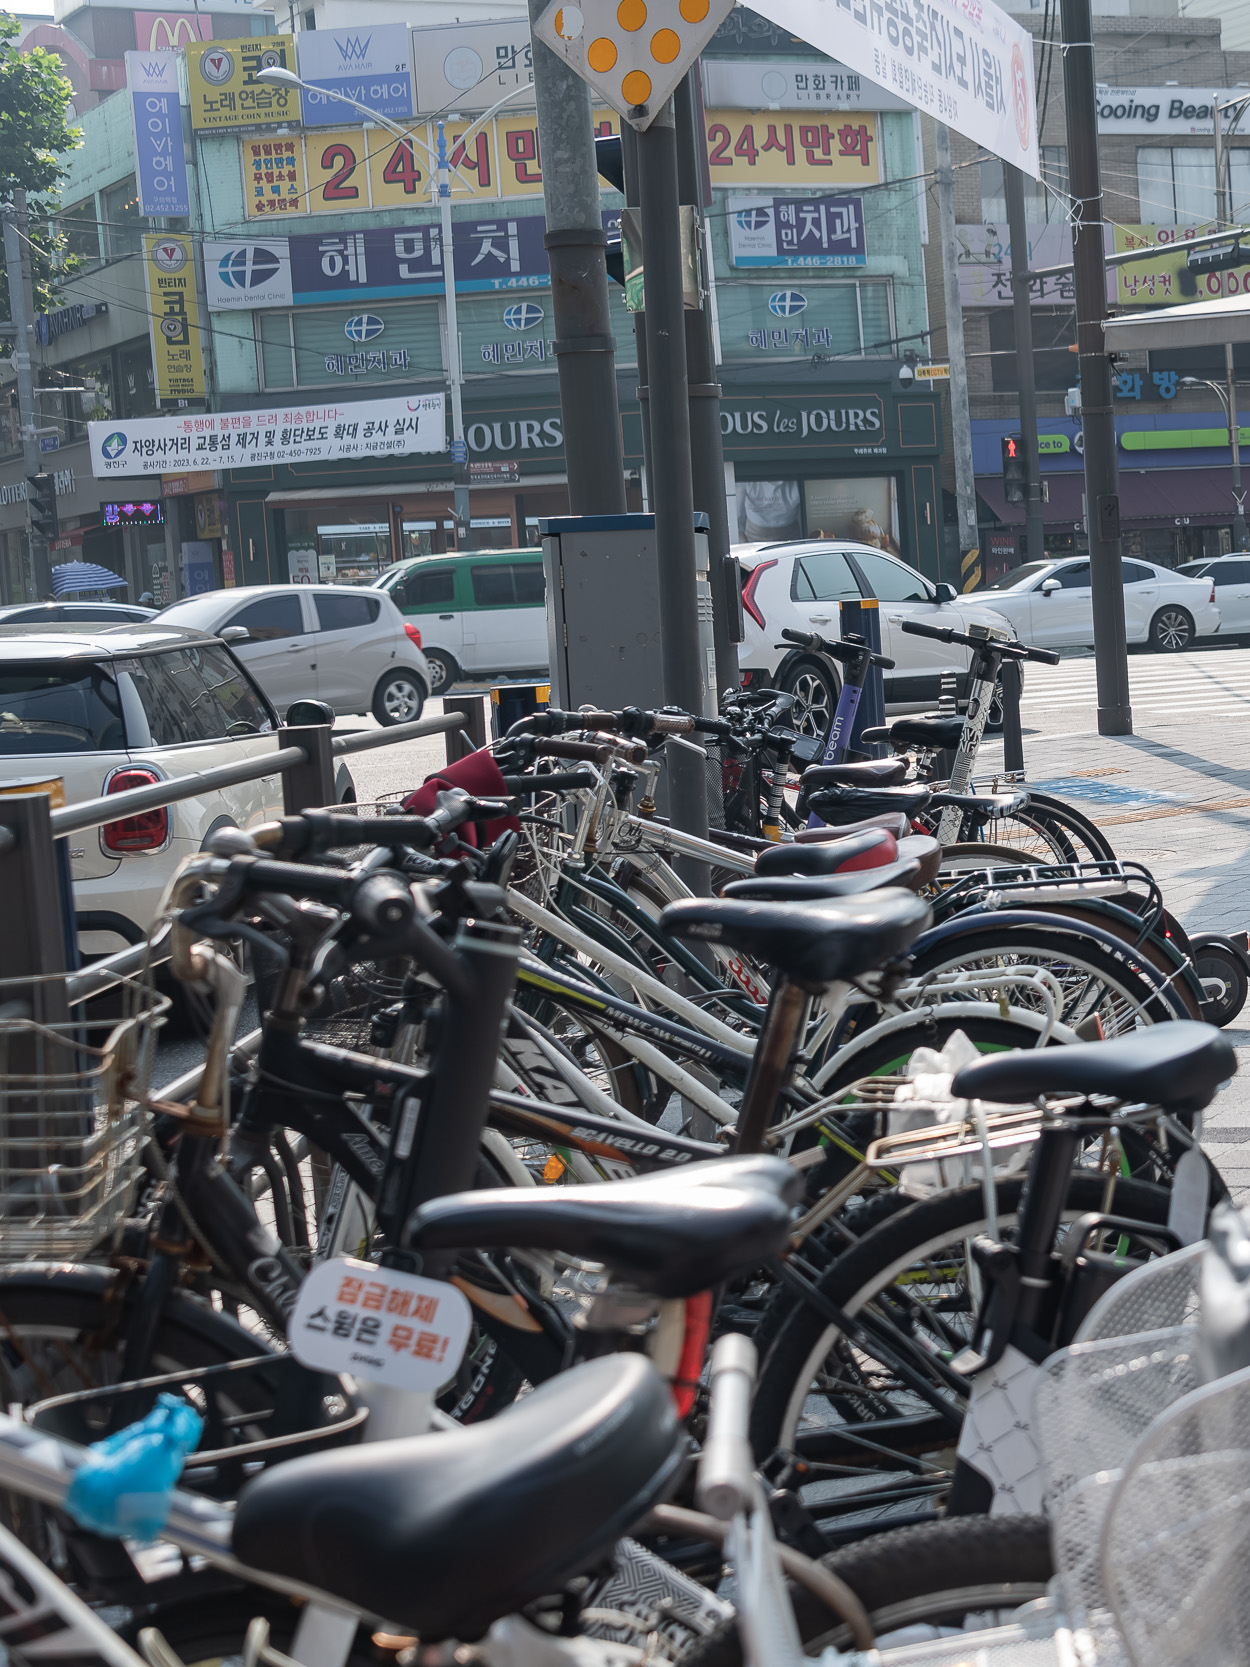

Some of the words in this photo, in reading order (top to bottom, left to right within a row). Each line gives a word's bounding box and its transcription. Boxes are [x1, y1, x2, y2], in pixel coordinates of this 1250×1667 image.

[337, 62, 355, 72] AVA
[355, 61, 373, 70] HAIR
[394, 63, 407, 72] 2F
[794, 73, 861, 92] 만화카페
[370, 82, 408, 100] 헤어
[796, 92, 861, 102] LIBRARY
[203, 91, 237, 113] 노래
[238, 88, 290, 111] 연습장
[203, 114, 240, 124] VINTAGE
[241, 112, 262, 121] COIN
[263, 110, 291, 119] MUSIC
[708, 123, 874, 167] 24시만화
[251, 156, 296, 171] 성인만화
[252, 169, 297, 185] 무협소설
[145, 204, 188, 212] 02.452.1255
[784, 256, 857, 267] T.446-2818
[157, 277, 187, 289] 빈티지
[217, 294, 243, 304] Haemin
[243, 293, 267, 303] Dental
[267, 291, 286, 301] Clinic
[167, 349, 191, 362] 노래
[166, 364, 192, 374] 연습장
[177, 399, 189, 408] B1
[219, 416, 253, 431] 불편을
[255, 414, 278, 427] 드려
[773, 409, 797, 433] les
[800, 408, 881, 439] JOURS
[132, 436, 191, 458] 자양사거리
[195, 433, 231, 452] 교통섬
[235, 430, 260, 449] 제거
[264, 429, 276, 447] 및
[279, 425, 329, 446] 횡단보도
[333, 422, 360, 439] 확대
[363, 419, 389, 438] 공사
[393, 416, 420, 437] 실시
[463, 417, 564, 453] OURS
[104, 459, 128, 469] 광진구
[142, 460, 167, 471] 공사기간
[250, 451, 275, 463] 광진구청
[276, 447, 322, 460] 02-450-7925
[338, 443, 359, 454] 시공사
[990, 536, 1016, 546] WINE
[823, 715, 845, 762] beam
[335, 1274, 440, 1325] 잠금해제
[304, 1305, 382, 1348] 스윙은
[386, 1322, 452, 1365] 무료!
